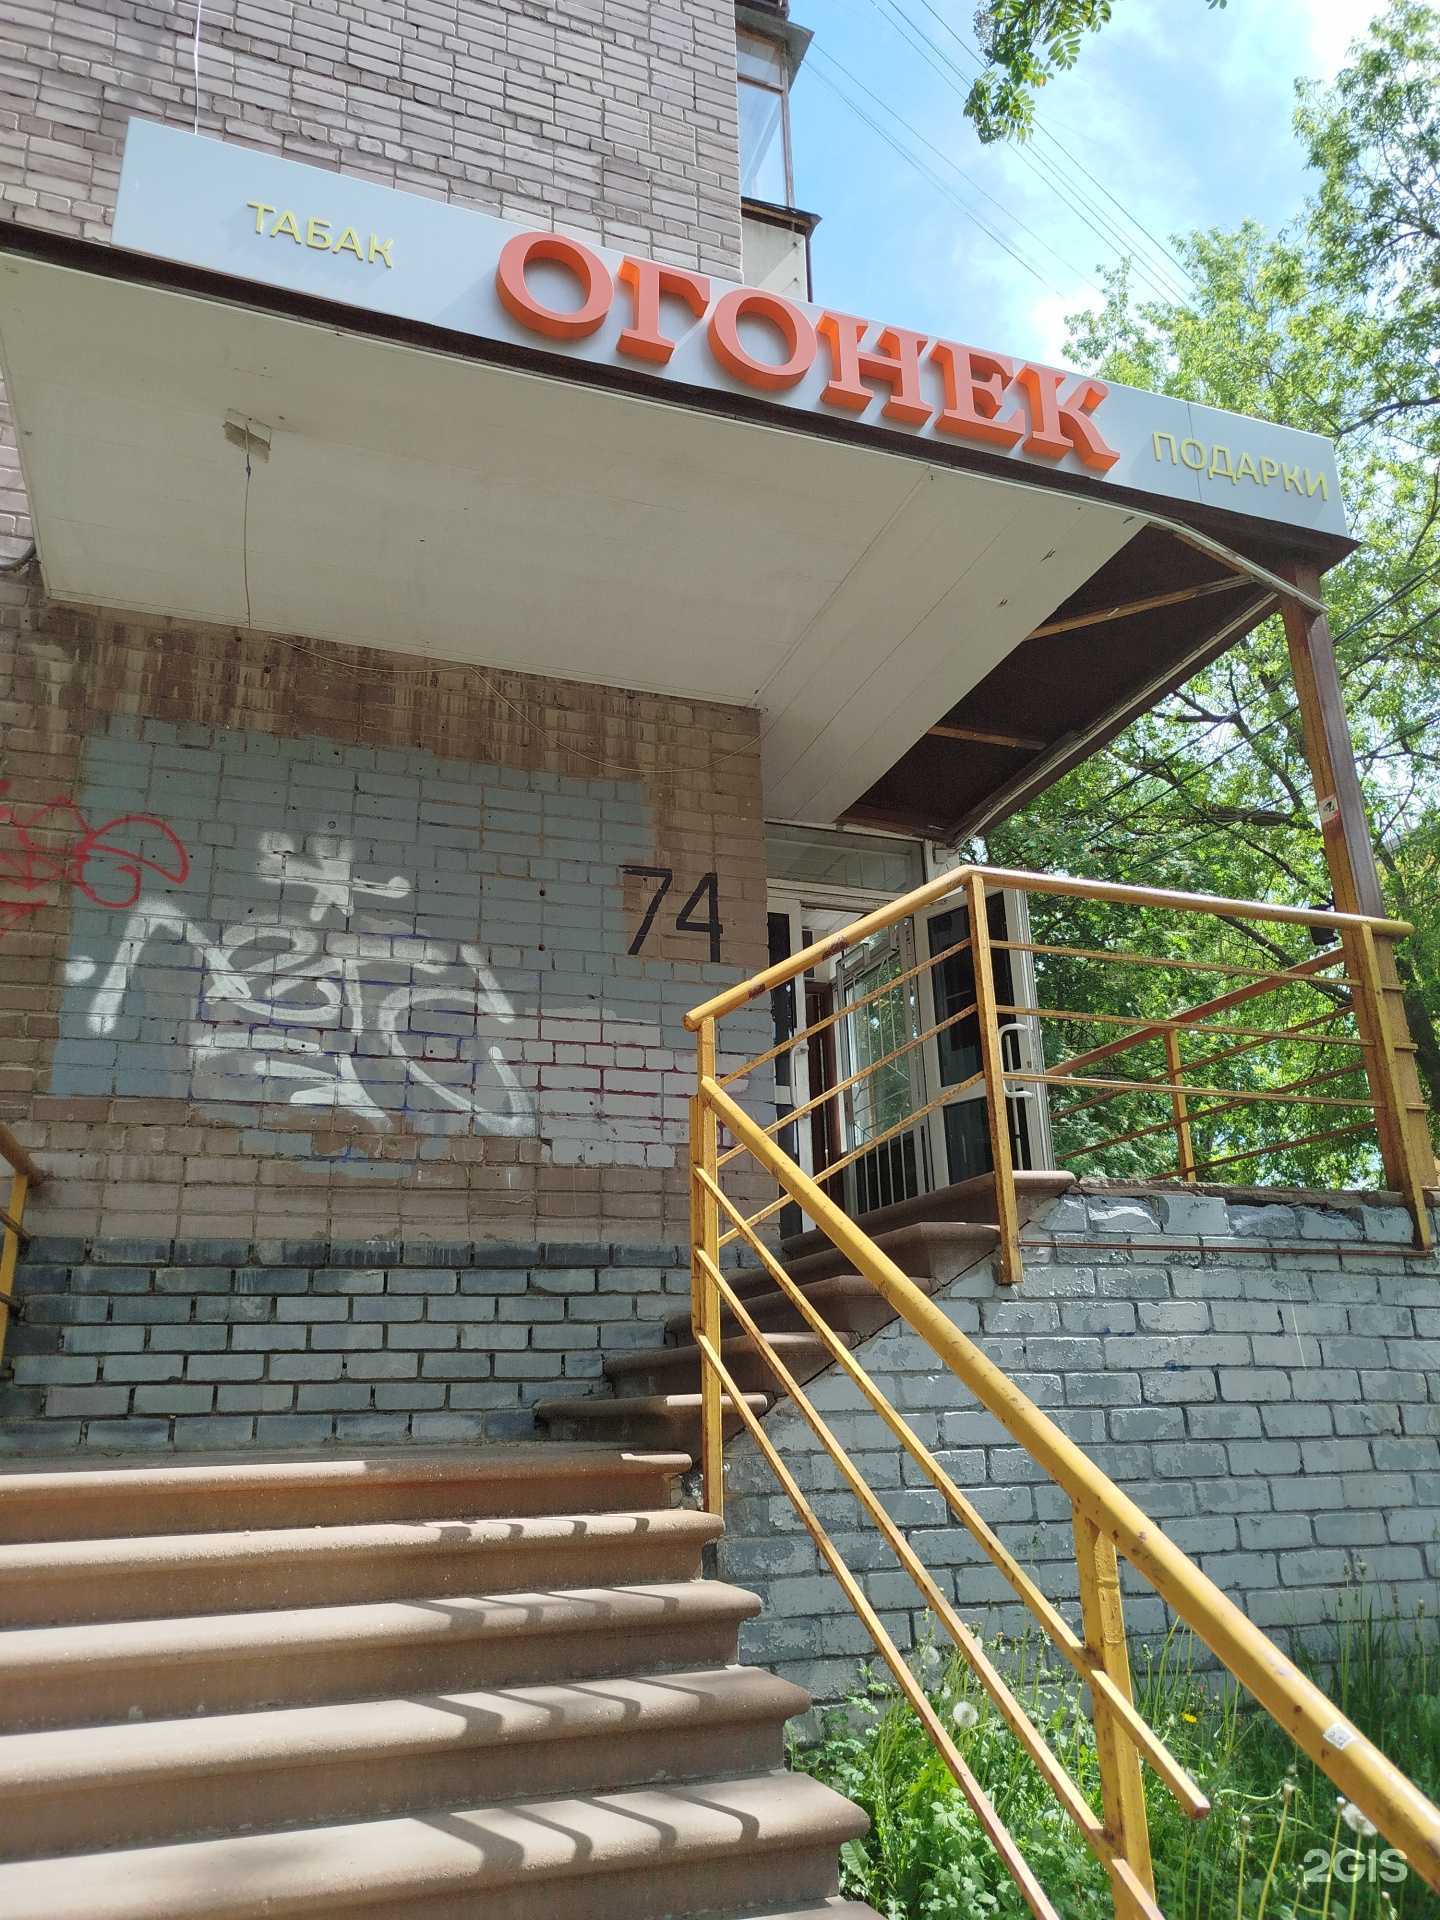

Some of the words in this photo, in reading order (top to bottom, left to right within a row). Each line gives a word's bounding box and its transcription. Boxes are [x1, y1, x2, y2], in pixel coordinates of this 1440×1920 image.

[248, 201, 395, 268] ТАБАК
[496, 231, 1120, 470] ОГОНЕК
[1153, 431, 1329, 502] ПОДАРКИ
[619, 864, 724, 963] 74
